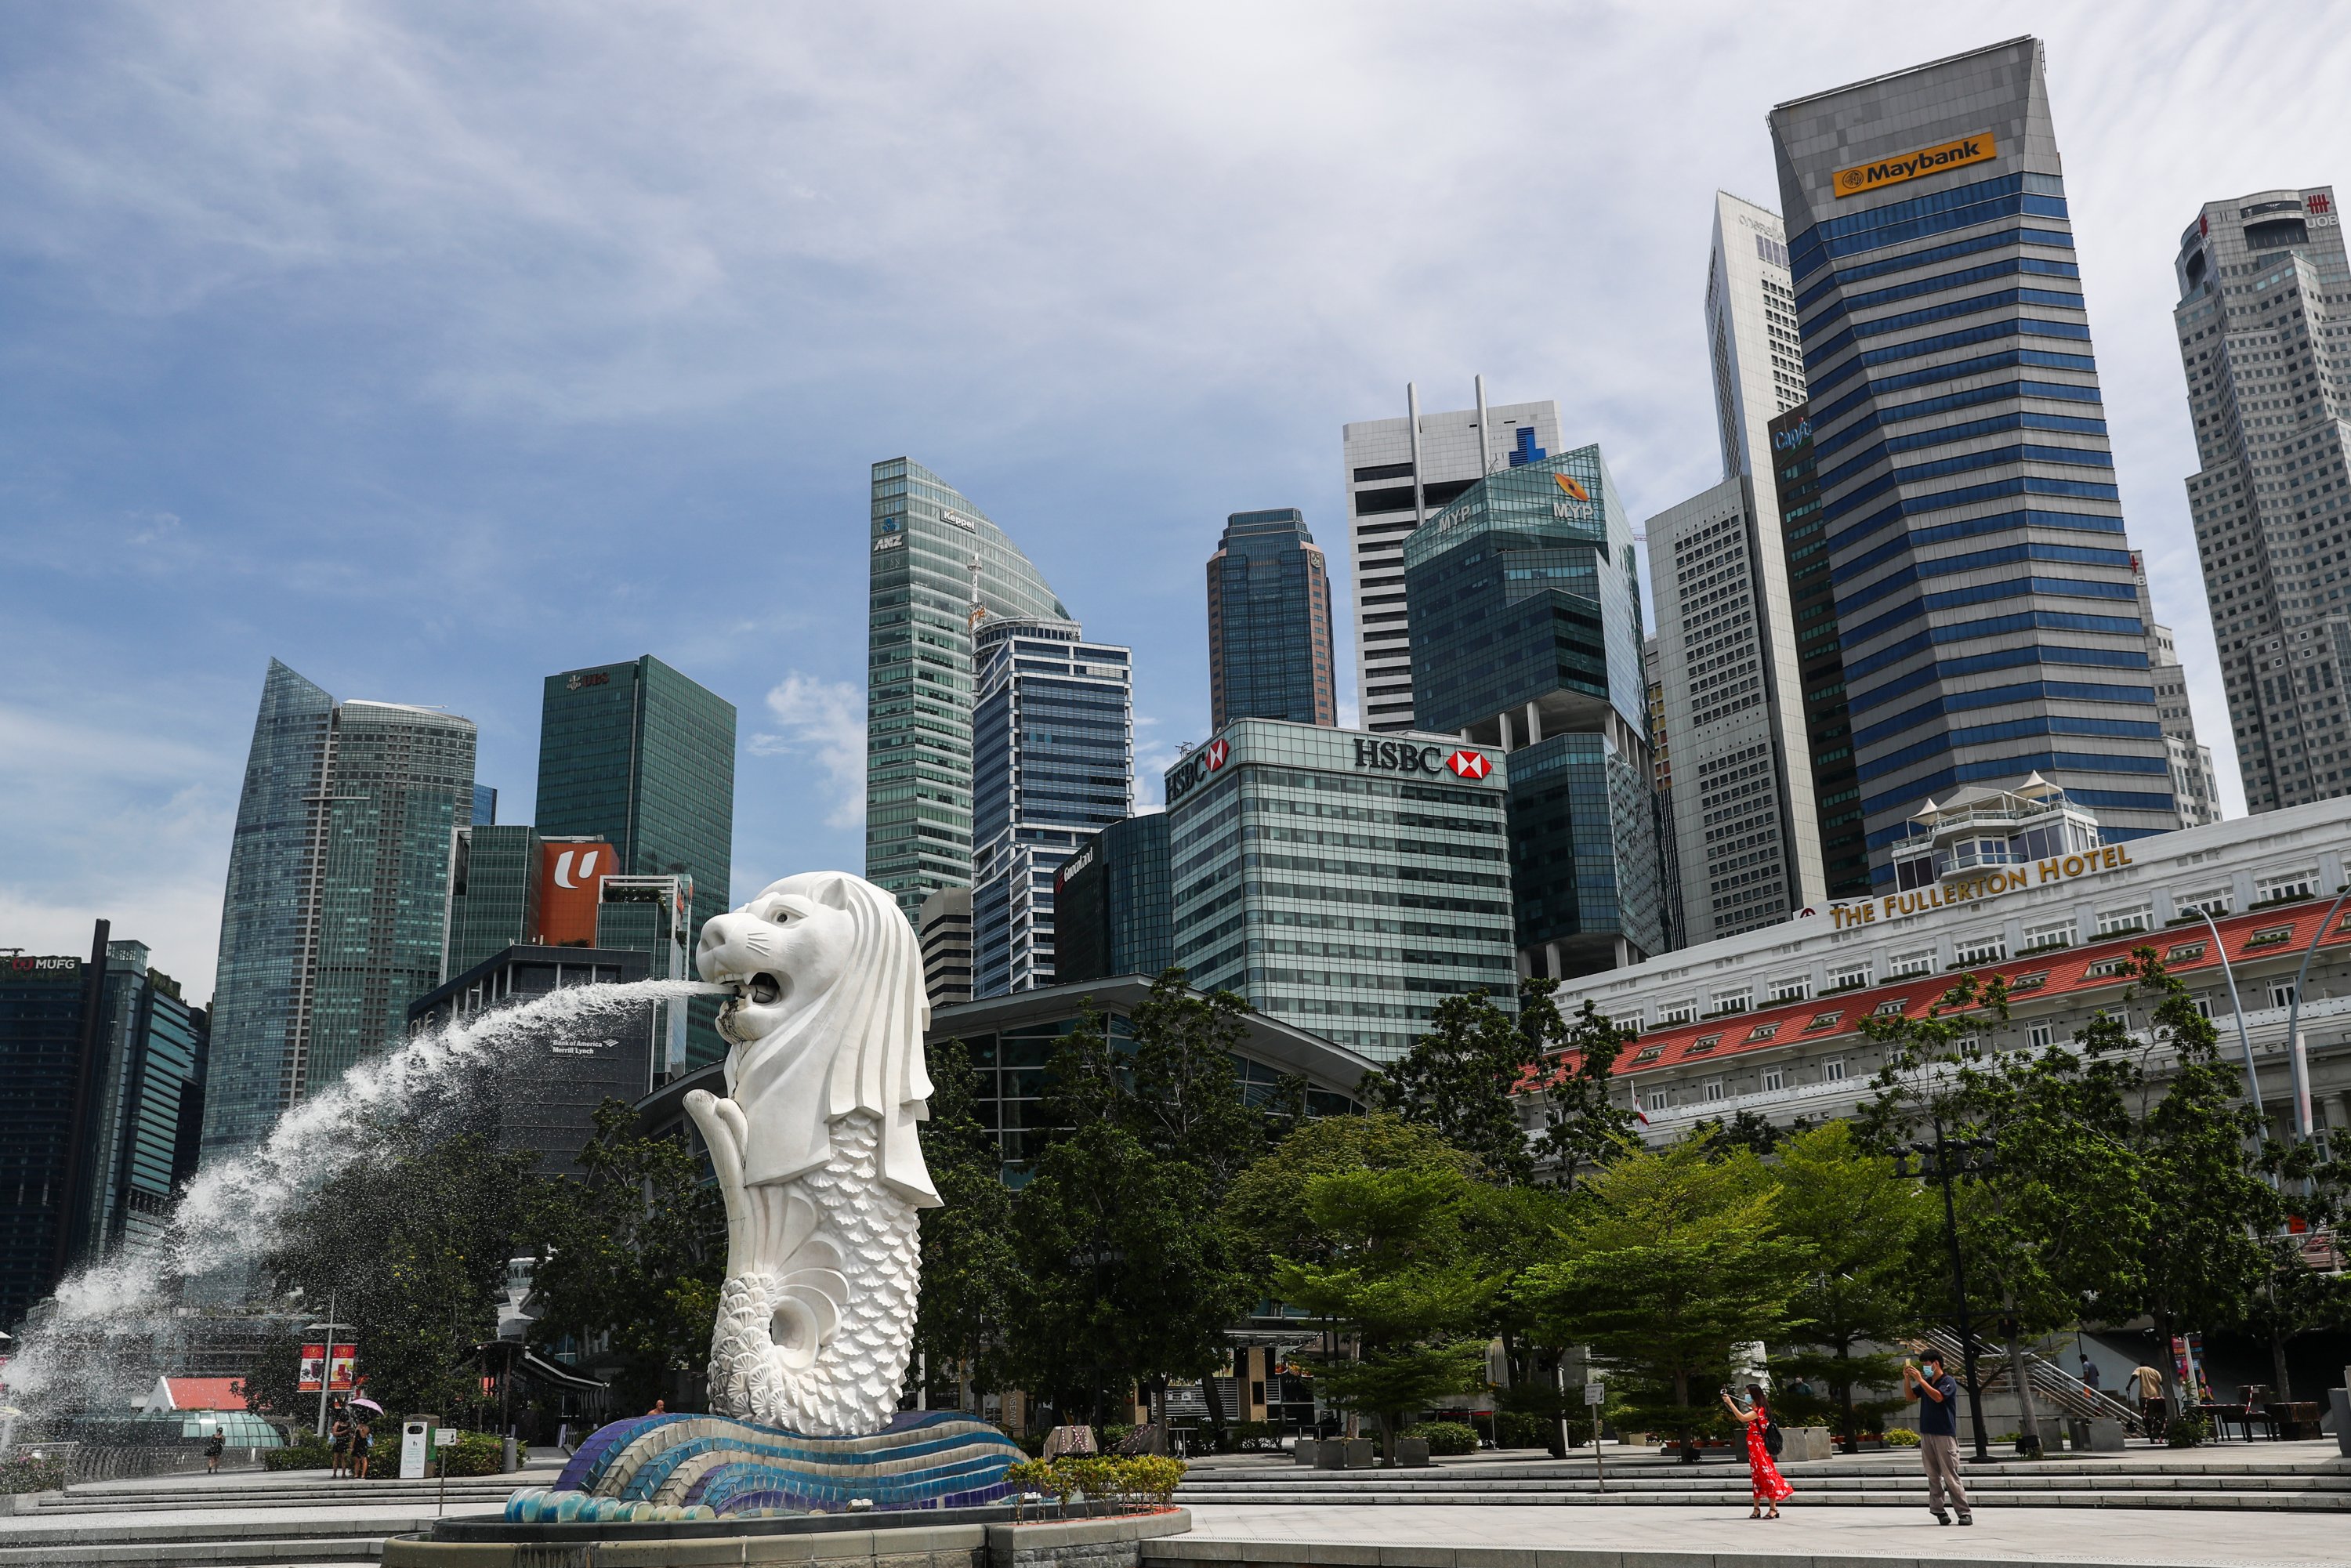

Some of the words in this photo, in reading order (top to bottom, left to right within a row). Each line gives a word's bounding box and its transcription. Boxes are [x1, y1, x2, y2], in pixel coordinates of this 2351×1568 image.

[1867, 141, 1981, 183] Maybank
[2305, 215, 2339, 229] UOB
[944, 510, 975, 530] Keppel
[1439, 505, 1471, 533] MYP
[1553, 502, 1594, 520] MYP
[874, 534, 903, 551] ANZ
[582, 672, 609, 687] UBS
[1354, 738, 1444, 773] HSBC
[1165, 751, 1205, 805] HSBC
[1830, 904, 1875, 929] THE
[1884, 867, 2027, 918] FULLERTON
[2038, 845, 2132, 882] HOTEL
[35, 958, 75, 969] MUFG
